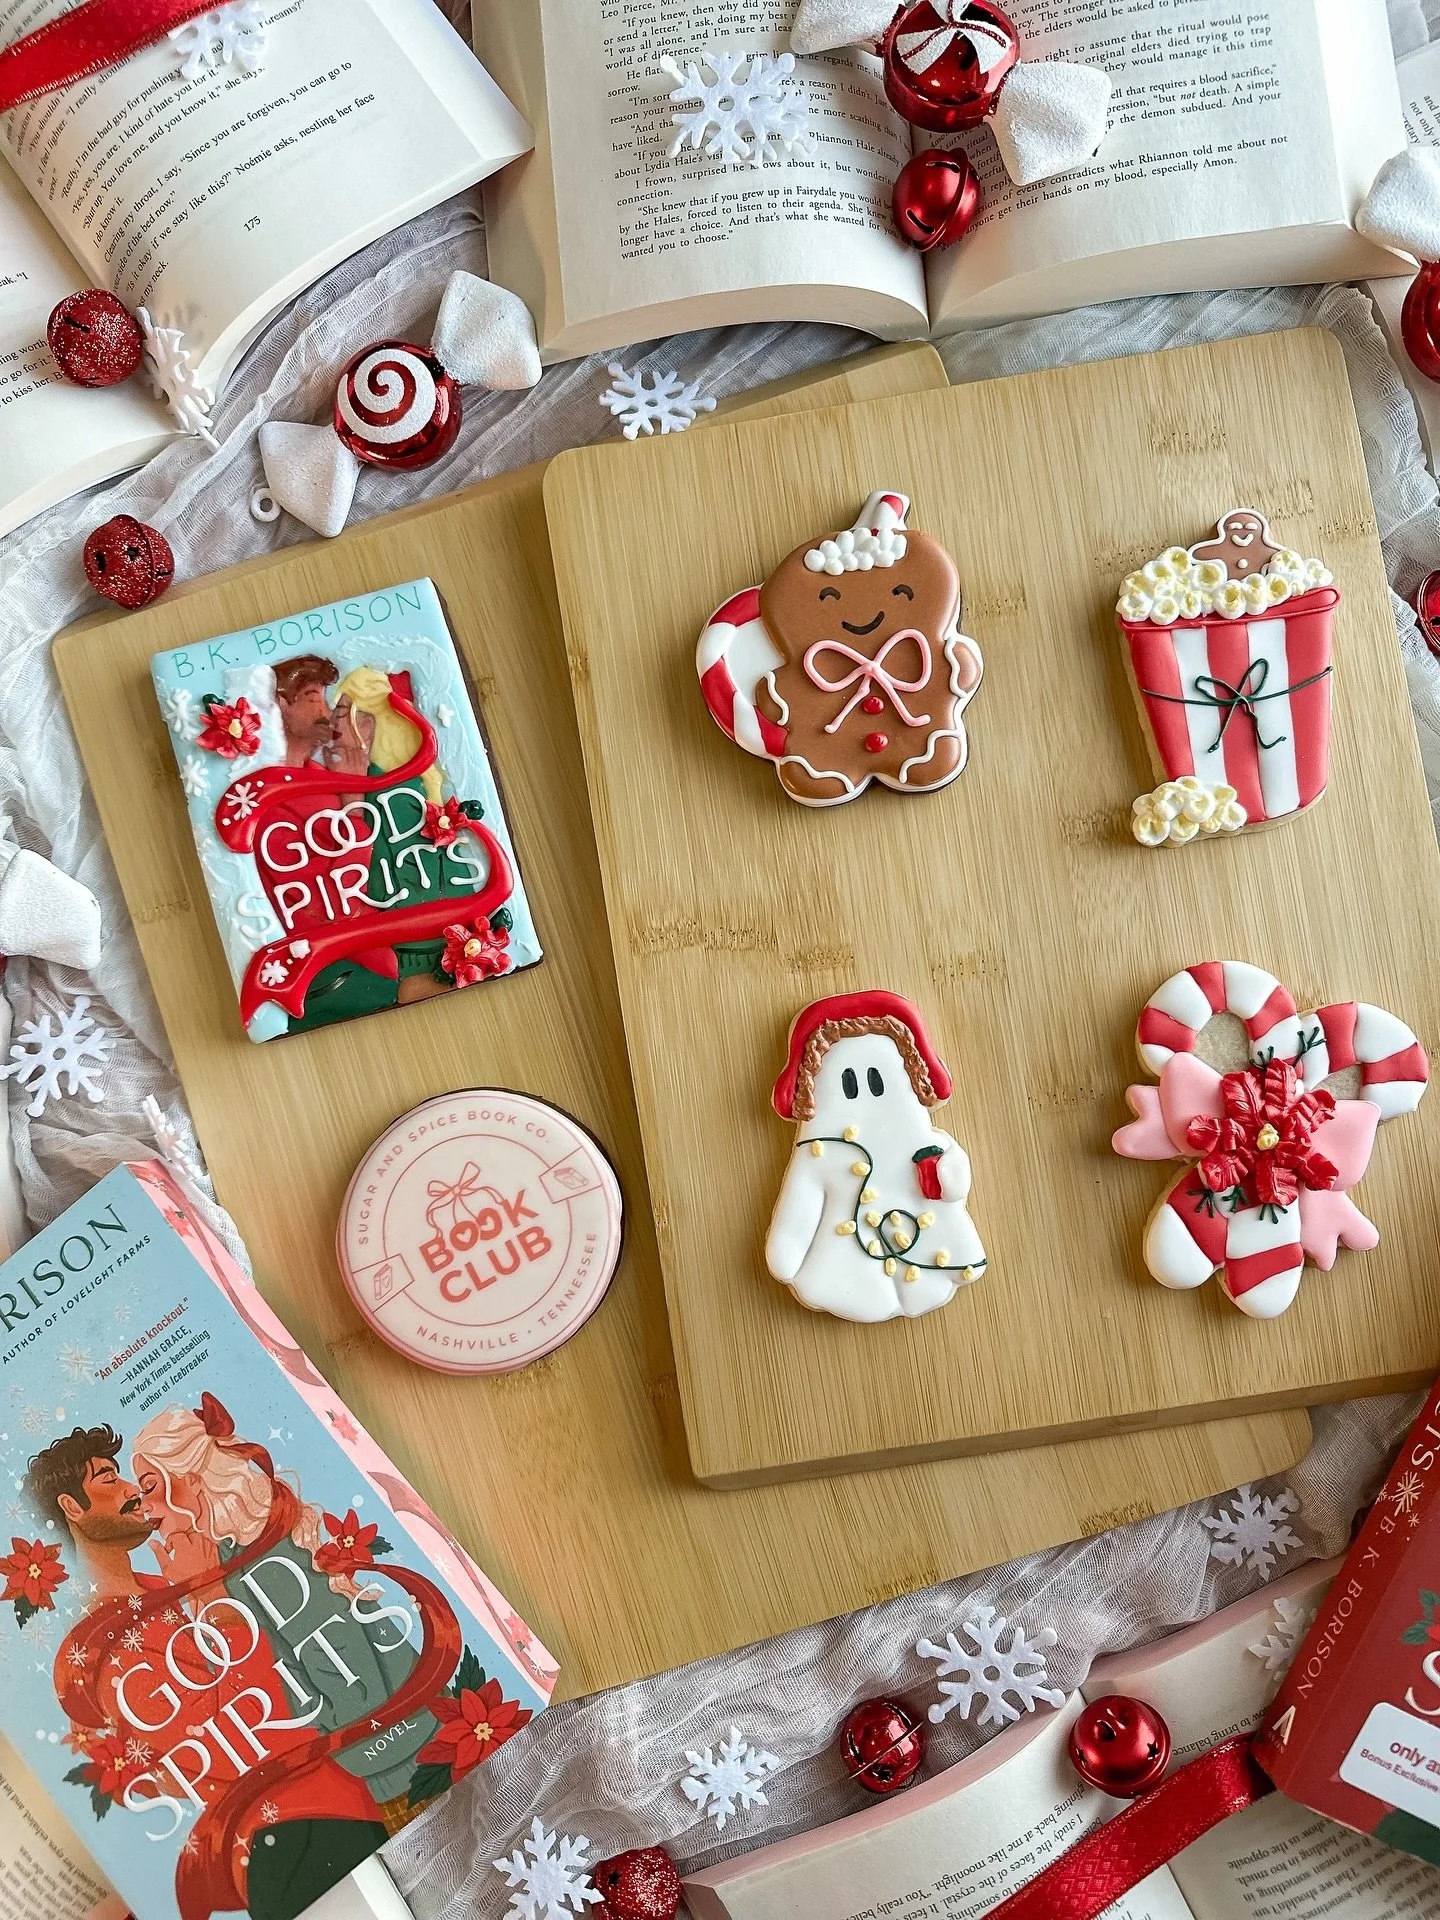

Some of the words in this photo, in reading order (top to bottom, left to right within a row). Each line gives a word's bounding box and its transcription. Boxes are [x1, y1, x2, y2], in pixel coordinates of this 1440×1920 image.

[1045, 48, 1070, 63] right
[1075, 45, 1085, 54] to
[1089, 36, 1127, 50] assume
[1132, 30, 1151, 41] that
[1156, 25, 1173, 37] the
[1177, 19, 1205, 33] ritual
[1209, 13, 1243, 28] would
[1246, 13, 1269, 26] pose
[1084, 45, 1125, 64] original
[1131, 41, 1162, 54] elders
[1167, 35, 1190, 48] died
[1196, 31, 1229, 45] trying
[1234, 30, 1245, 38] to
[1251, 26, 1272, 37] trap
[1104, 61, 1127, 73] they
[1131, 51, 1164, 67] would
[1168, 48, 1208, 61] manage
[1213, 45, 1221, 55] it
[1226, 41, 1245, 52] this
[1250, 38, 1273, 49] time
[1125, 85, 1146, 97] that
[1149, 79, 1188, 93] requires
[1199, 70, 1228, 85] blood
[1181, 91, 1197, 101] not
[1199, 85, 1230, 98] death.
[1235, 82, 1243, 93] A
[1246, 77, 1280, 91] simple
[211, 129, 230, 147] you
[230, 119, 247, 132] are
[246, 97, 290, 122] forgiven,
[289, 85, 309, 101] you
[309, 75, 327, 88] can
[327, 68, 341, 81] go
[341, 62, 352, 73] to
[1120, 113, 1136, 124] the
[1140, 108, 1176, 120] demon
[1181, 98, 1226, 114] subdued.
[1231, 93, 1253, 107] And
[1258, 92, 1281, 105] your
[1408, 101, 1423, 117] not
[1419, 117, 1435, 137] only
[233, 149, 273, 176] Noémie
[273, 136, 299, 152] asks,
[298, 114, 337, 138] nestling
[335, 104, 353, 118] her
[354, 93, 375, 108] face
[1003, 189, 1013, 202] of
[1015, 181, 1046, 197] events
[1049, 164, 1106, 186] contradicts
[1109, 159, 1135, 171] what
[1138, 150, 1189, 165] Rhiannon
[1192, 144, 1213, 156] told
[1218, 144, 1233, 153] me
[1237, 139, 1266, 150] about
[1271, 135, 1288, 145] not
[662, 201, 687, 212] knew
[690, 196, 708, 207] that
[711, 192, 719, 204] if
[720, 193, 739, 205] you
[741, 190, 765, 202] grew
[768, 189, 780, 199] up
[784, 186, 793, 195] in
[795, 185, 837, 198] Fairydale
[840, 191, 856, 201] you
[857, 193, 883, 209] would
[997, 205, 1012, 220] get
[1015, 195, 1039, 210] their
[1042, 185, 1073, 201] hands
[1077, 183, 1090, 192] on
[1094, 177, 1110, 189] my
[1113, 167, 1147, 183] blood,
[1151, 159, 1199, 177] especially
[1204, 157, 1237, 168] Amon.
[243, 215, 262, 233] 175
[618, 224, 631, 236] by
[635, 220, 650, 231] the
[653, 213, 683, 227] Hales,
[687, 206, 717, 220] forced
[722, 207, 732, 215] to
[737, 202, 763, 213] listen
[783, 198, 805, 209] their
[809, 199, 844, 211] agenda.
[847, 202, 864, 214] She
[619, 234, 649, 247] longer
[654, 229, 675, 240] have
[680, 227, 686, 235] a
[689, 220, 724, 233] choice.
[728, 214, 750, 227] And
[785, 210, 809, 221] what
[814, 211, 829, 222] she
[833, 215, 865, 227] wanted
[868, 217, 881, 231] for
[621, 243, 655, 260] wanted
[658, 242, 676, 255] you
[680, 239, 690, 247] to
[9, 370, 23, 382] go
[23, 362, 39, 373] for
[2, 396, 13, 405] to
[11, 385, 34, 399] kiss
[32, 376, 54, 389] her.
[250, 585, 423, 656] BORISON
[260, 786, 430, 873] GOOD
[236, 837, 487, 940] SPIRITS
[359, 1185, 378, 1244] SUGAR
[376, 1144, 403, 1177] AND
[408, 1113, 458, 1142] SPICE
[467, 1110, 516, 1126] BOOK
[525, 1122, 549, 1143] CO.
[419, 1188, 540, 1274] BOOK
[439, 1226, 553, 1303] CLUB
[2, 1327, 43, 1364] AUTHOR
[44, 1312, 59, 1327] OF
[61, 1265, 116, 1314] LOVELIGHT
[116, 1235, 151, 1267] FARMS
[416, 1326, 519, 1350] NASHVILLE
[538, 1233, 596, 1326] TENNESSEE
[111, 1336, 148, 1370] absolute
[160, 1324, 192, 1353] GRACE,
[120, 1392, 136, 1408] New
[134, 1378, 152, 1396] York
[150, 1361, 172, 1383] Times
[170, 1330, 210, 1366] bestselling
[139, 1389, 163, 1411] author
[162, 1381, 172, 1393] of
[170, 1349, 210, 1385] Icebreaker
[1375, 1515, 1396, 1535] B.
[1358, 1546, 1380, 1568] K.
[116, 1556, 311, 1732] GOOD
[1297, 1578, 1363, 1699] BORISON
[123, 1582, 413, 1841] SPIRITS
[371, 1720, 382, 1730] A
[1240, 1717, 1252, 1727] to
[364, 1720, 418, 1761] NOVEL
[1171, 1736, 1214, 1757] balance
[1210, 1723, 1242, 1742] bring
[1360, 1748, 1392, 1770] Bonus
[1394, 1764, 1438, 1793] Exclusive
[1390, 1742, 1426, 1766] only
[1053, 1781, 1086, 1817] glinting
[1024, 1830, 1034, 1843] at
[1033, 1812, 1058, 1836] back
[987, 1848, 1009, 1864] like
[1006, 1837, 1024, 1852] me
[931, 1859, 987, 1892] moonlight.
